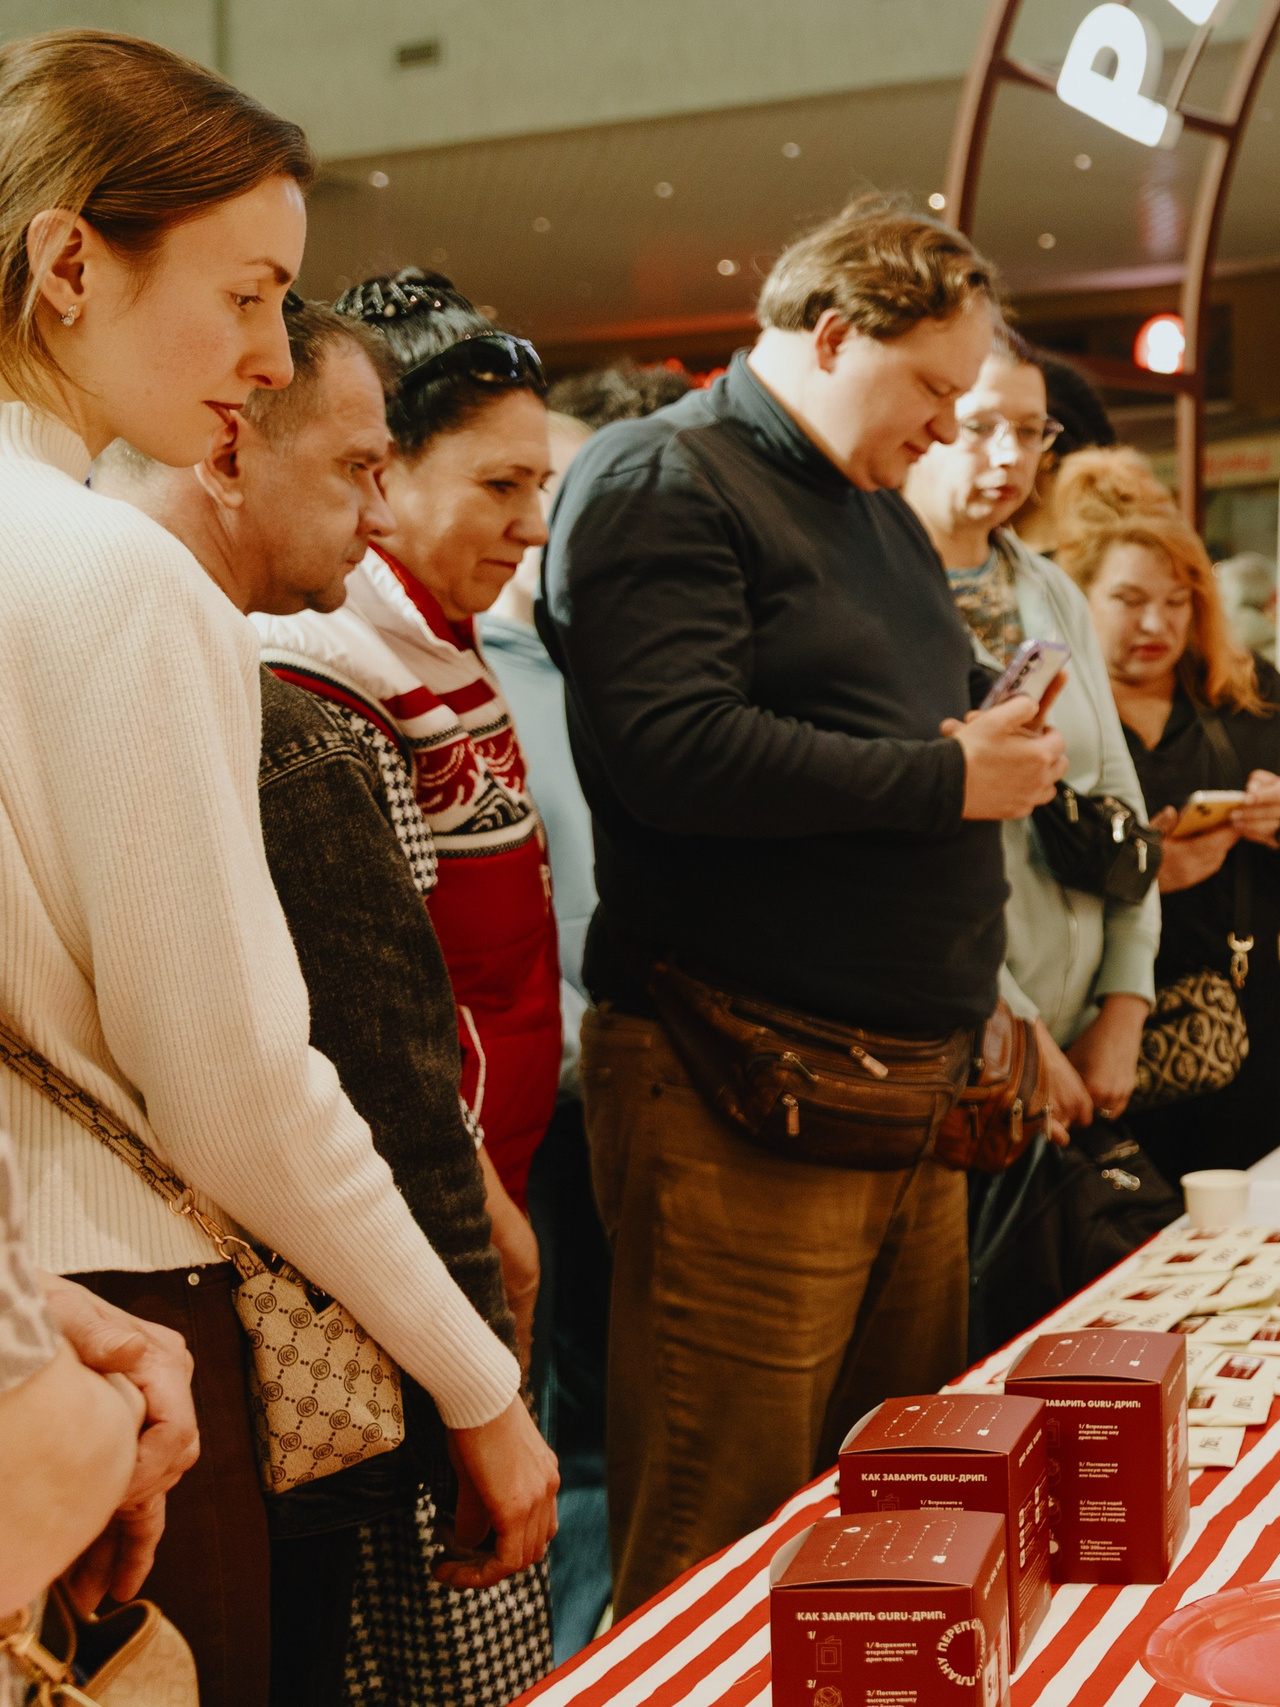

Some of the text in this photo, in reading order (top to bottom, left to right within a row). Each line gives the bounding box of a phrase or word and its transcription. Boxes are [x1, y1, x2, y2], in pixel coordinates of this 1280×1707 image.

[1087, 1399, 1141, 1410] GURU-ДРИП:
[861, 1473, 988, 1483] КАК ЗАВАРИТЬ GURU-ДРИП:
[797, 1611, 946, 1622] КАК ЗАВАРИТЬ GURU-ДРИП:
